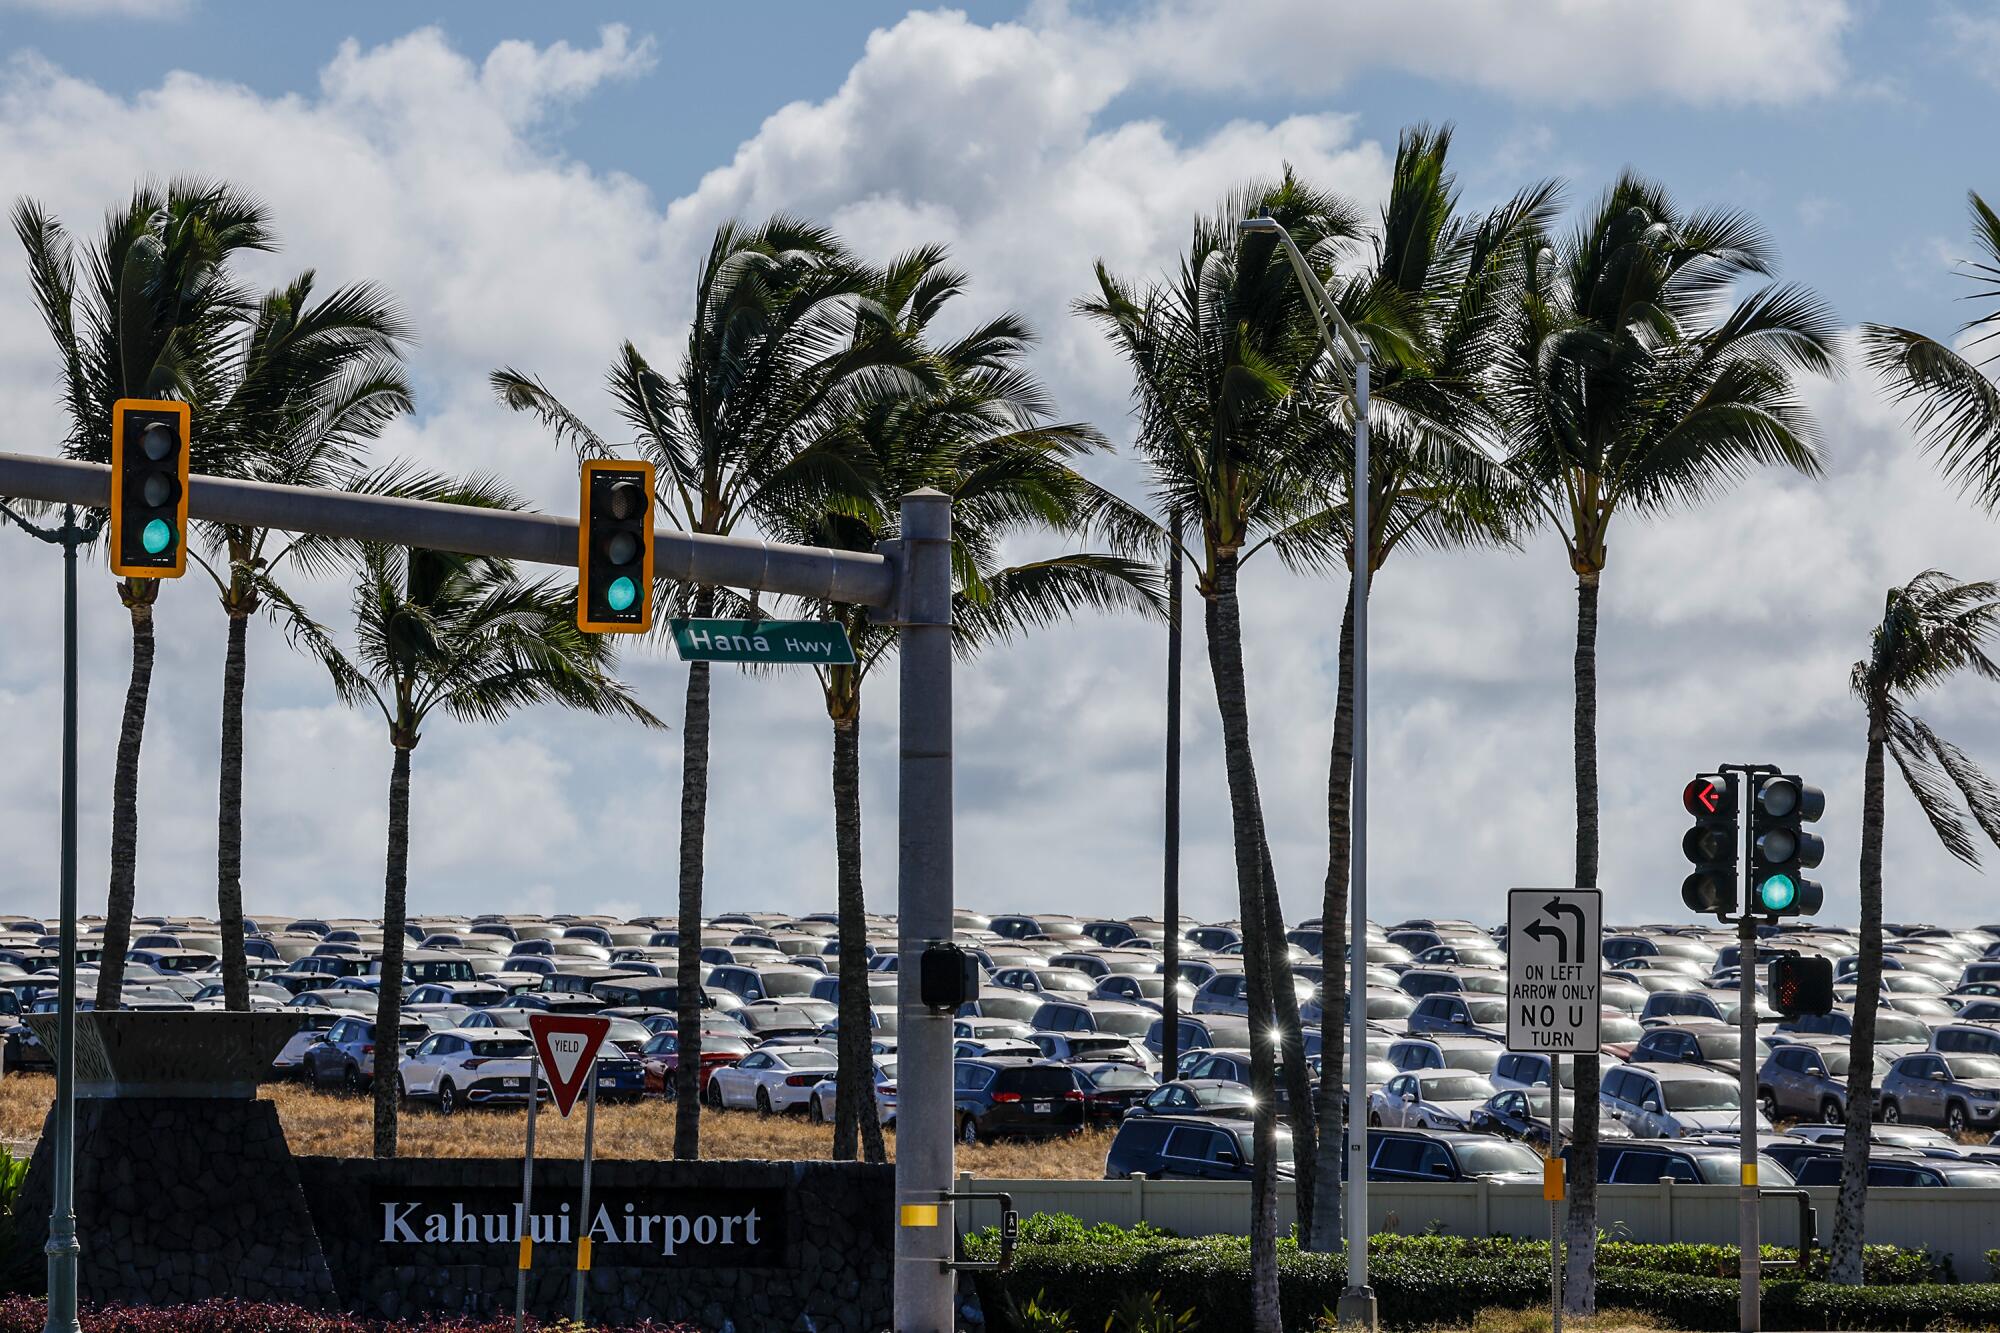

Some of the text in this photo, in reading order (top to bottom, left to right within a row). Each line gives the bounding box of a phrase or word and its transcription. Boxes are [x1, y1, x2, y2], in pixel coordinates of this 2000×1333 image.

[688, 629, 832, 656] Hana Hwy
[1525, 965, 1583, 981] ON LEFT
[1513, 984, 1595, 1000] ARROW ONLY
[1521, 1005, 1583, 1027] NO U
[554, 1039, 579, 1053] YIELD
[1531, 1031, 1574, 1047] TURN
[379, 1202, 761, 1256] Kahului Airport
